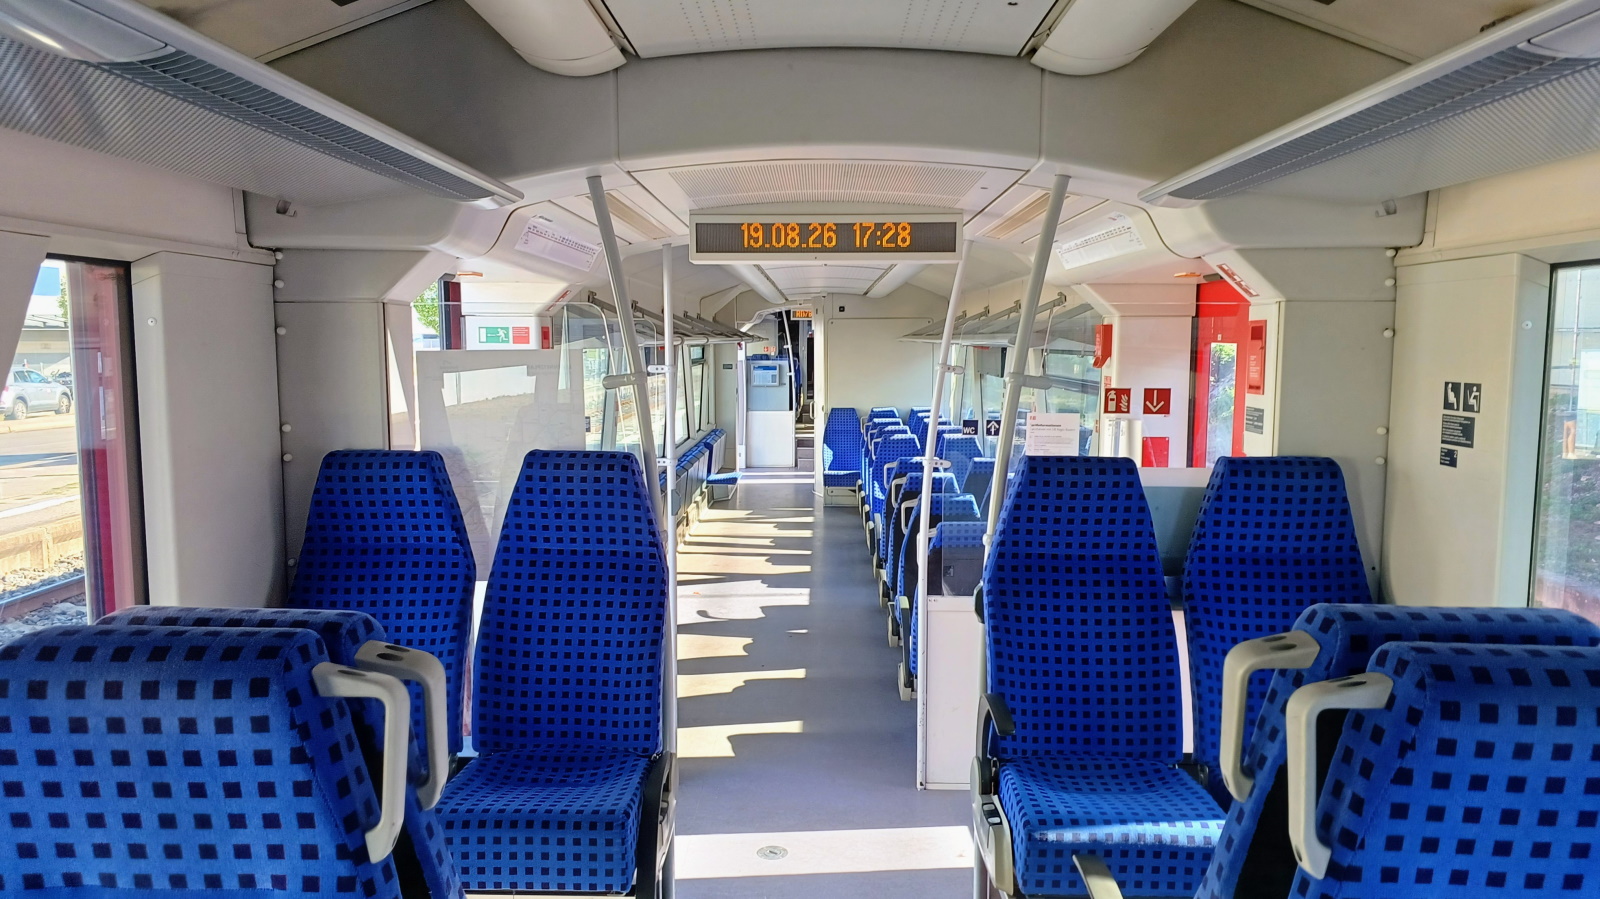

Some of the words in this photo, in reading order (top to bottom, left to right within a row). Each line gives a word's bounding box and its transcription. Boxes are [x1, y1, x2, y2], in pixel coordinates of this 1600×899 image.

[740, 222, 838, 248] 19.08.26
[853, 222, 911, 248] 17:28
[963, 426, 976, 434] WC
